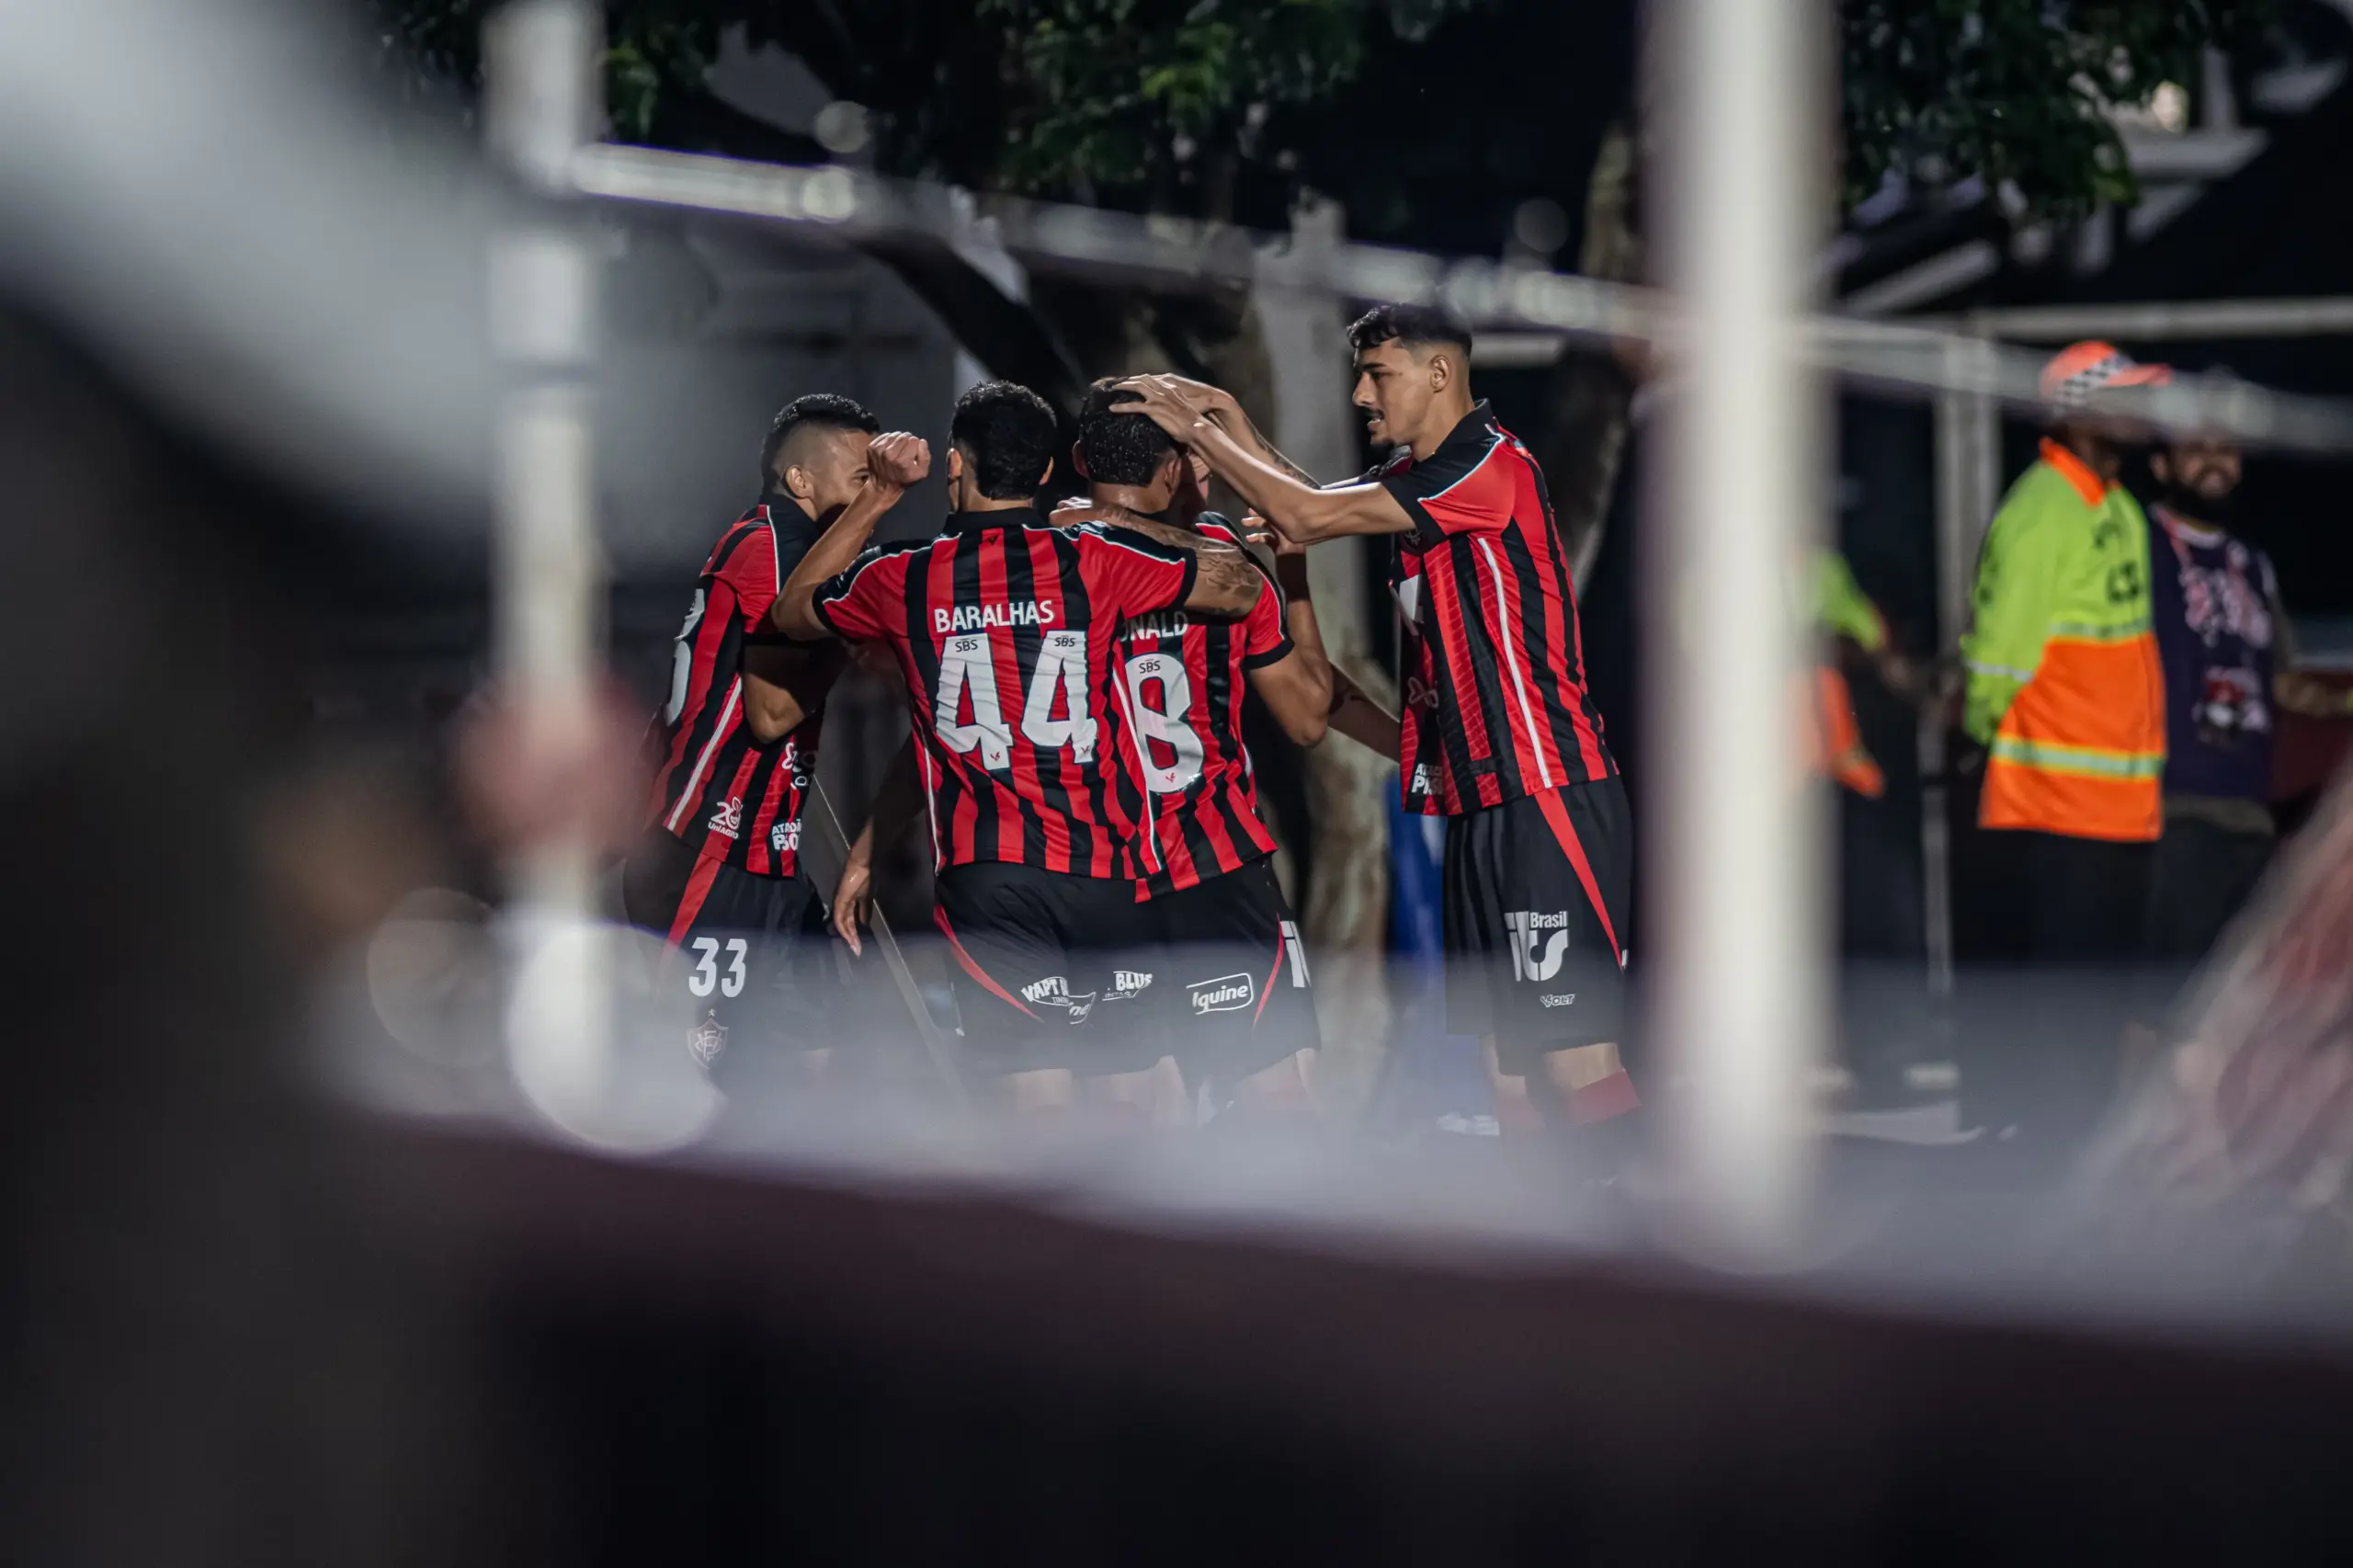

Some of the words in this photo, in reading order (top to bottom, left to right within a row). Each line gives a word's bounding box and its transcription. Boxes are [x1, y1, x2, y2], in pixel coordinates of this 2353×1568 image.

[934, 600, 1055, 633] BARALHAS
[955, 639, 979, 653] SBS
[1053, 636, 1076, 647] SBS
[1139, 660, 1161, 675] SBS
[936, 631, 1098, 771] 44
[1529, 911, 1568, 928] Brasil
[689, 937, 748, 998] 33
[1021, 979, 1060, 1003] VAPT
[1192, 984, 1249, 1012] Iquine
[1540, 994, 1575, 1007] VOLT
